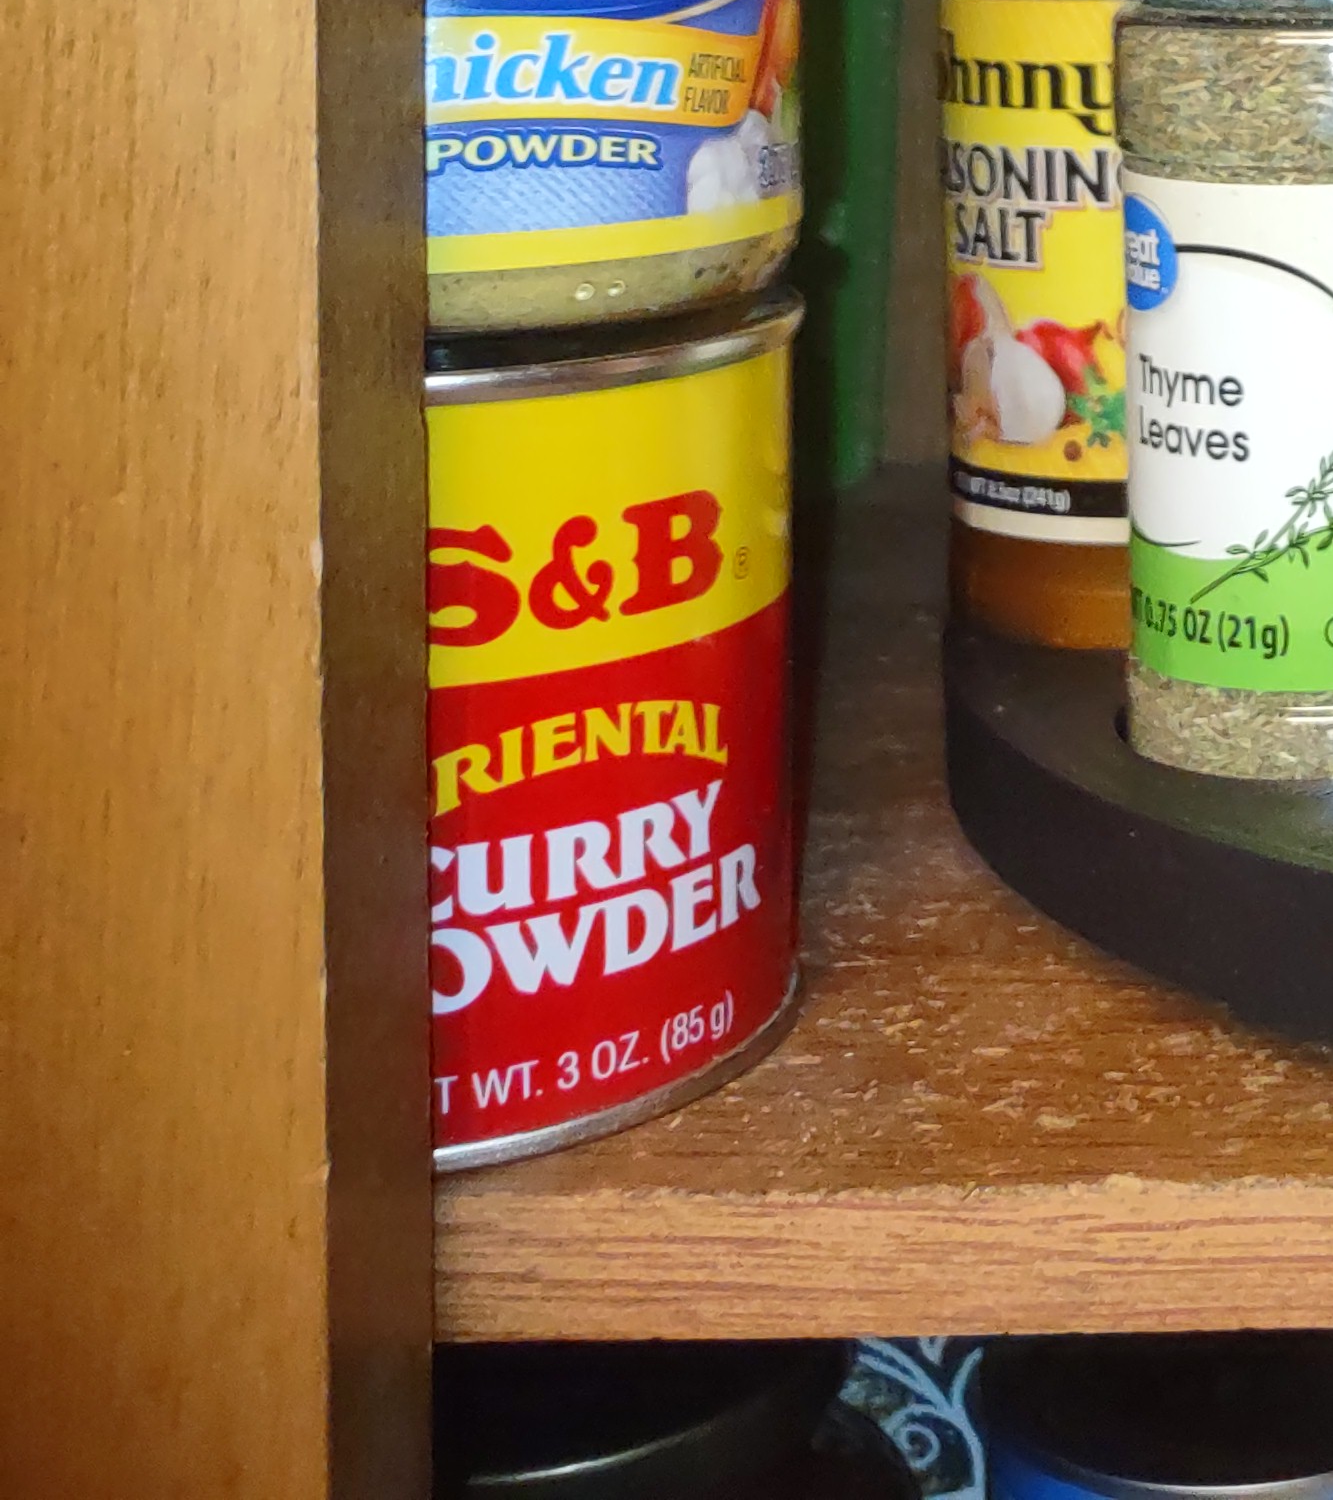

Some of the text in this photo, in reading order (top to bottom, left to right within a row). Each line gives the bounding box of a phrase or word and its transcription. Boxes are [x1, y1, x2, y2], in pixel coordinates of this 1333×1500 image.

[426, 30, 681, 107] icken
[431, 133, 662, 171] POWDER
[955, 203, 1046, 264] SALT
[1138, 352, 1245, 408] Thyme
[1138, 404, 1251, 462] Leaves
[429, 488, 725, 648] S&B
[1183, 605, 1214, 646] OZ
[1217, 609, 1291, 661] (21g)
[431, 699, 729, 818] RIENTAL
[430, 841, 762, 1016] OWDER
[471, 1060, 545, 1109] WT.
[556, 1051, 580, 1091] 3
[592, 1030, 651, 1079] OZ.
